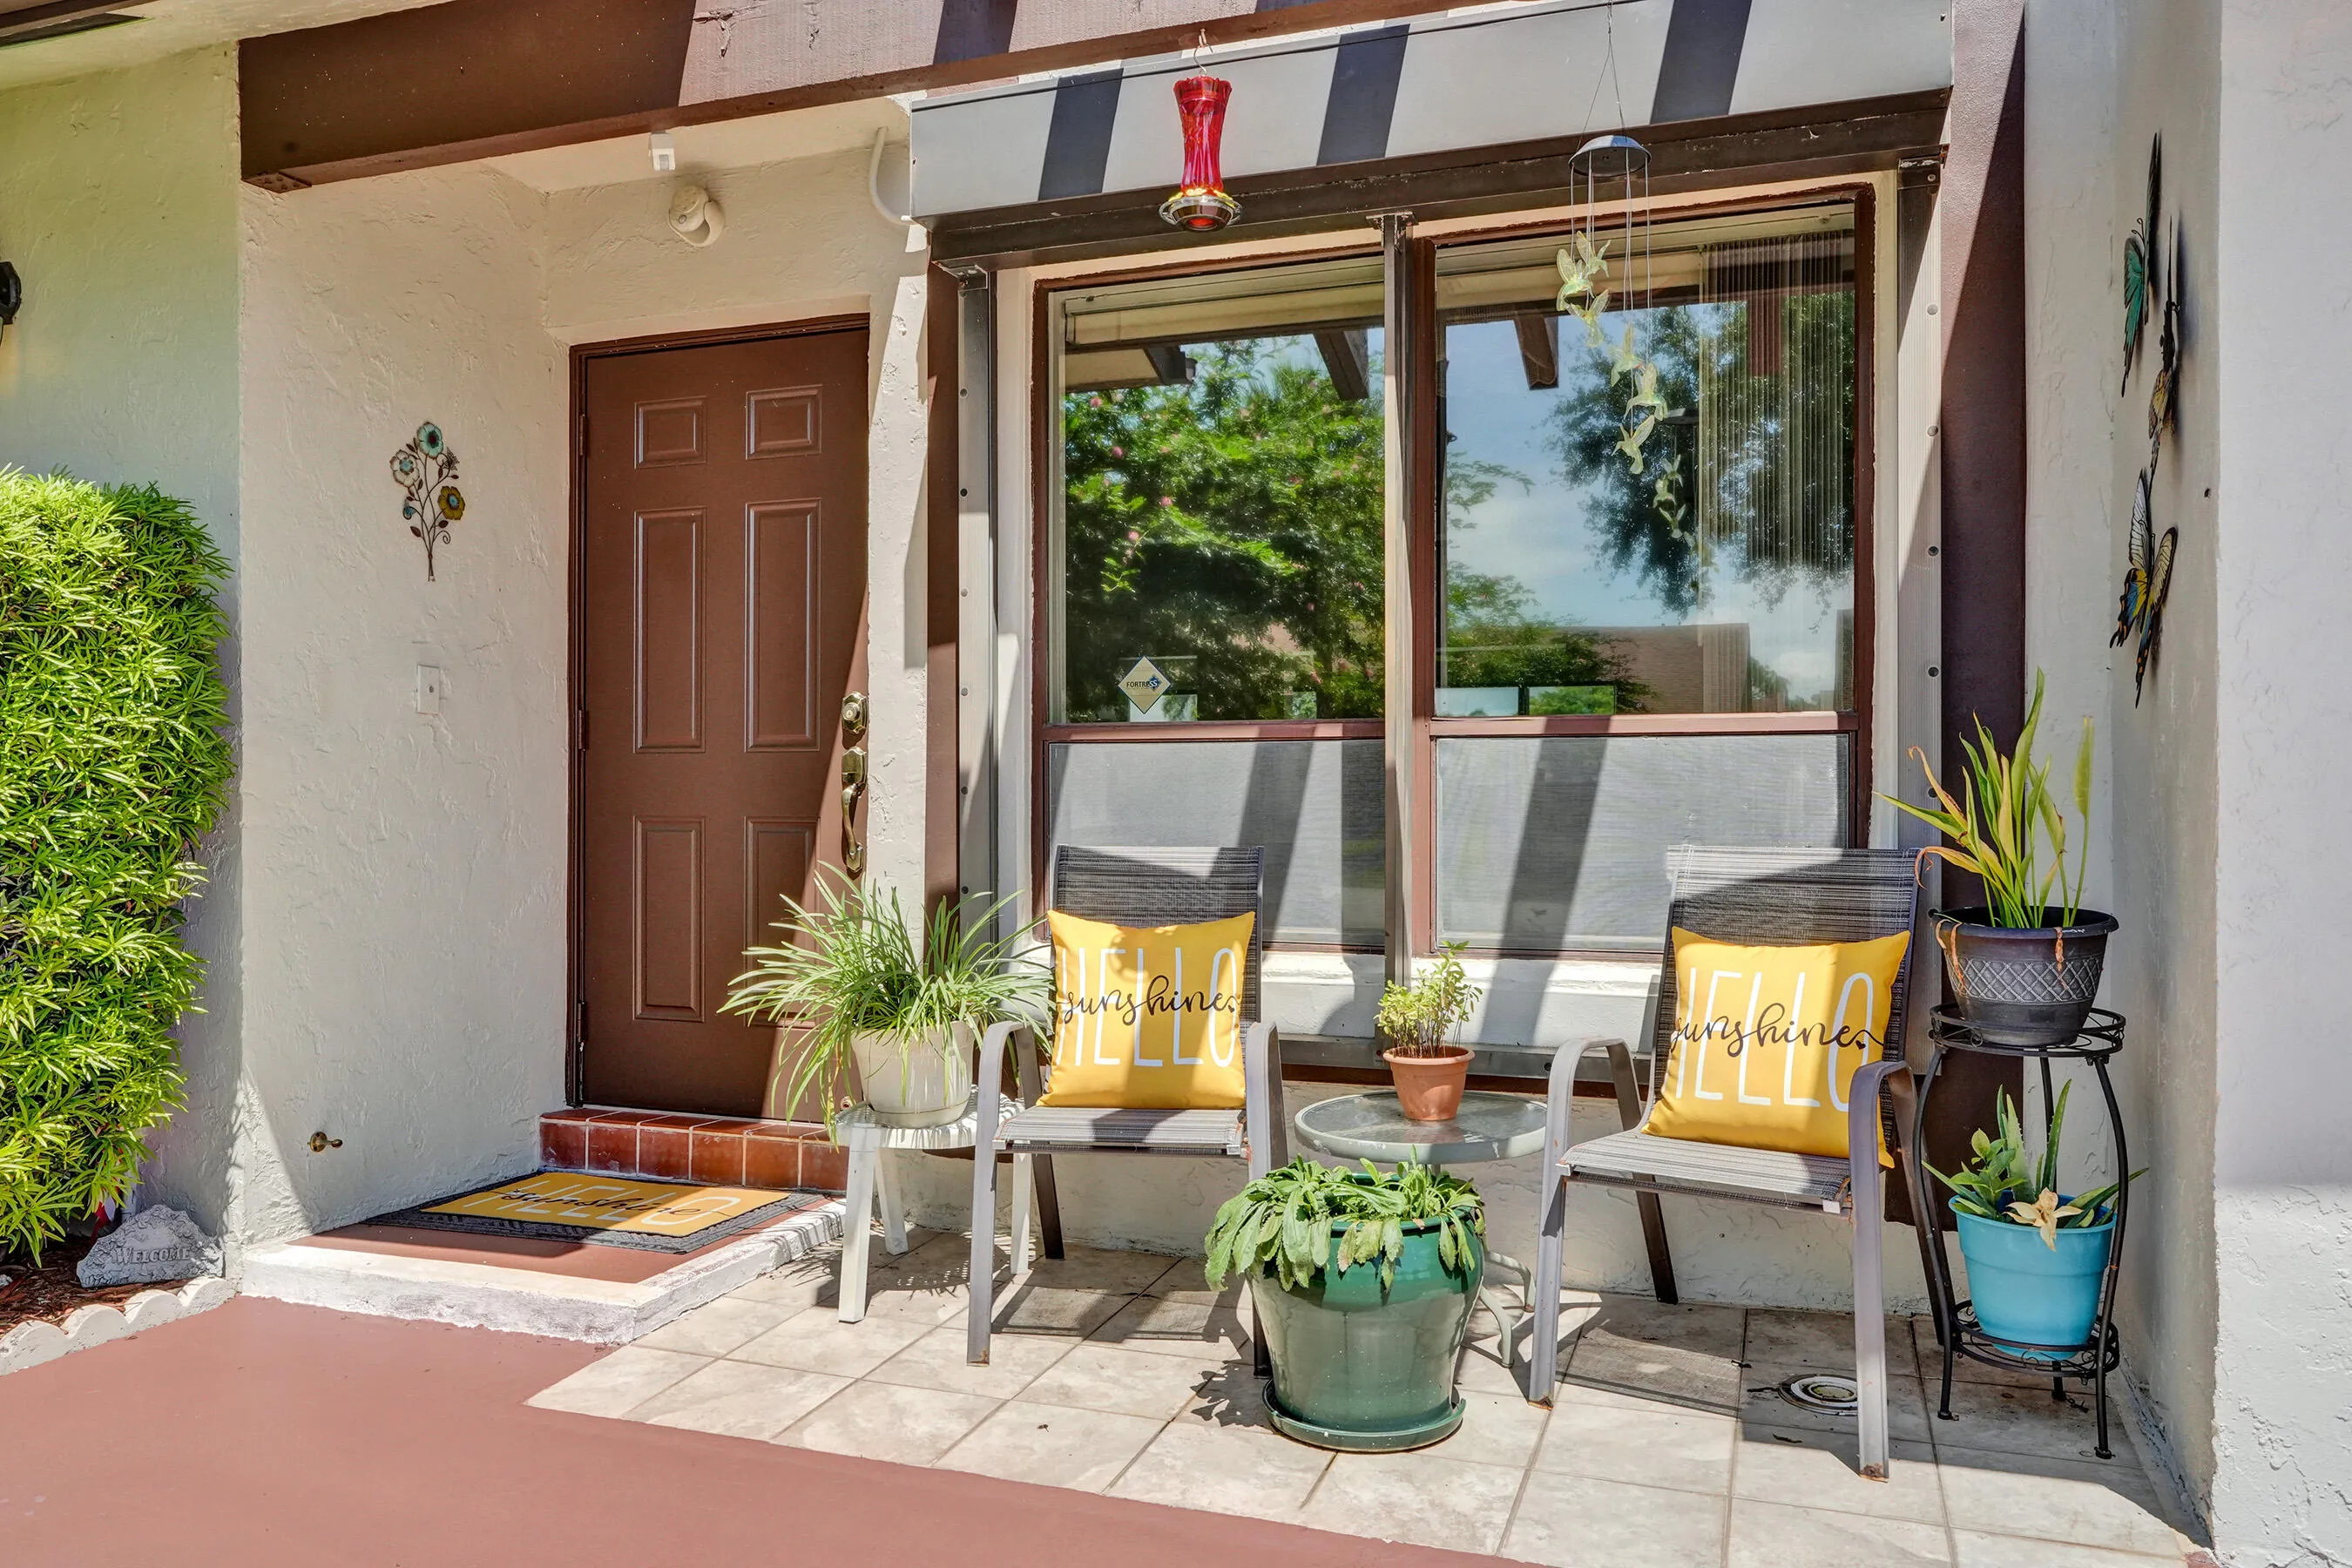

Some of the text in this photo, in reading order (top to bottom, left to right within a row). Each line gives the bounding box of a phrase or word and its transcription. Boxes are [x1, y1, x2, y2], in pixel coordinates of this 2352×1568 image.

[1126, 679, 1158, 688] FORTRESS
[1056, 947, 1237, 1067] HELLO
[1058, 975, 1238, 1026] sunshine
[1670, 1003, 1883, 1058] sunshine
[463, 1179, 741, 1226] HELLO
[110, 1247, 191, 1265] WELCOME
